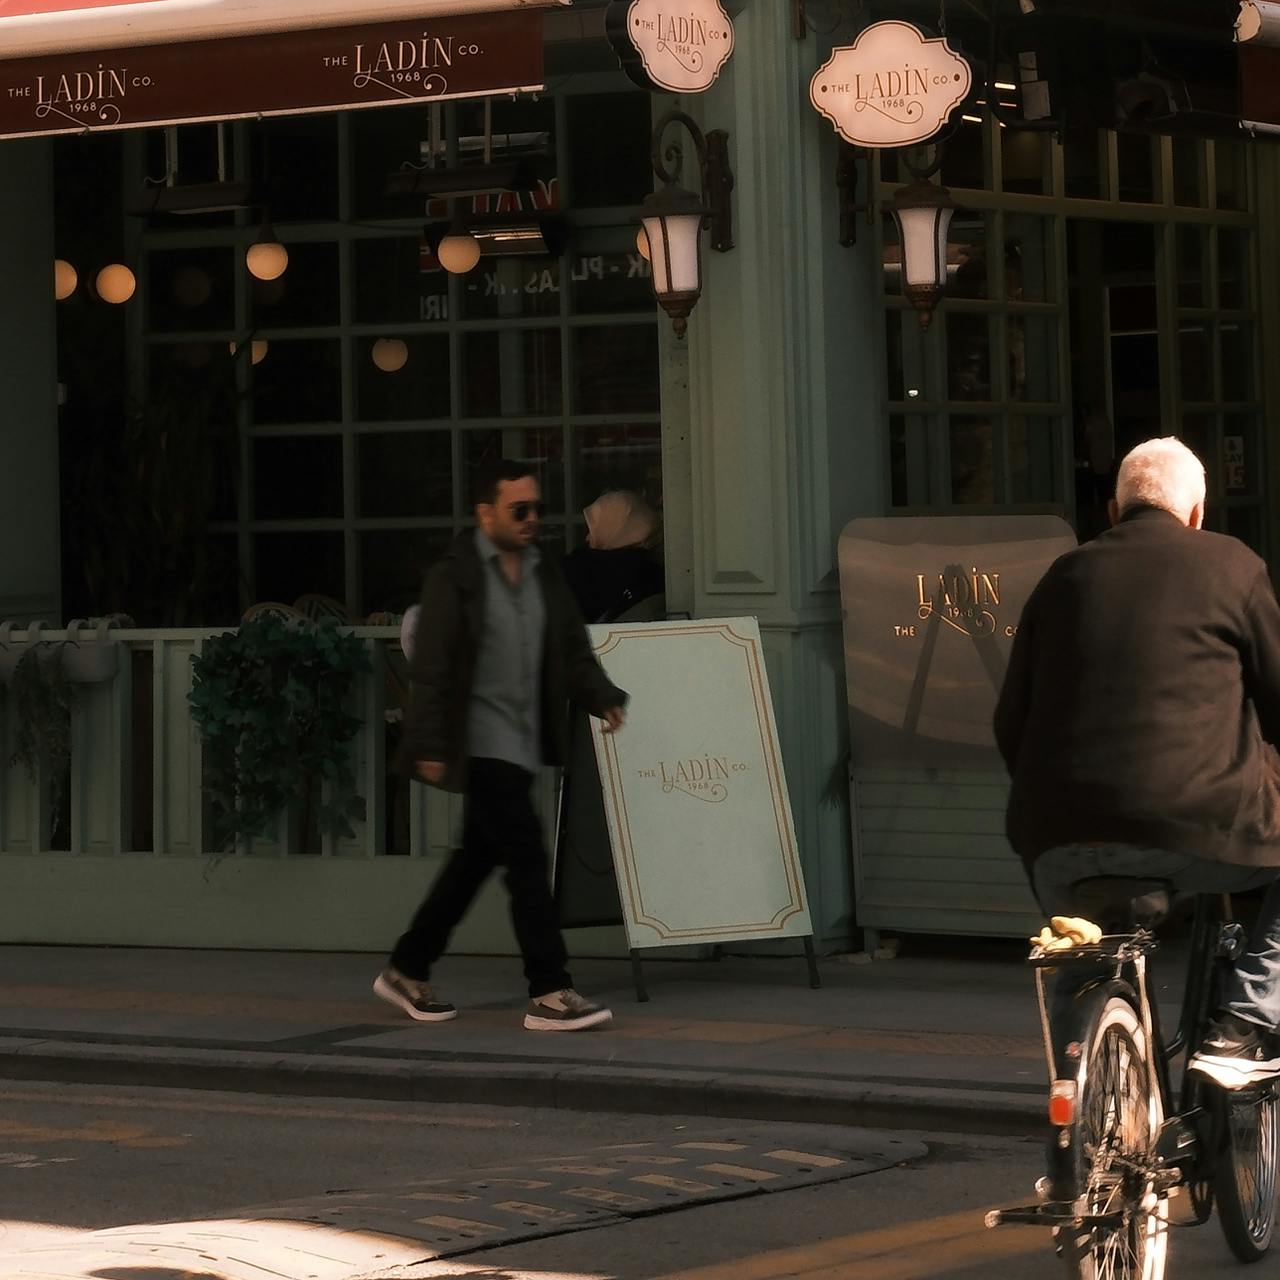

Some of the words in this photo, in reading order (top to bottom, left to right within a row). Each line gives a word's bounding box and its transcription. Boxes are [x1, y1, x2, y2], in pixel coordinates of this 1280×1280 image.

[642, 20, 654, 30] THE
[657, 12, 707, 46] LADİN
[323, 56, 348, 67] THE
[354, 32, 455, 74] LADİN
[8, 87, 31, 98] THE
[36, 64, 128, 105] LADİN
[391, 72, 421, 83] 1968
[831, 84, 850, 93] THE
[855, 64, 928, 100] LADİN
[70, 102, 97, 113] 1968
[882, 99, 905, 108] 1968
[894, 626, 916, 636] THE
[638, 770, 656, 778] THE
[657, 753, 729, 782] LADİN
